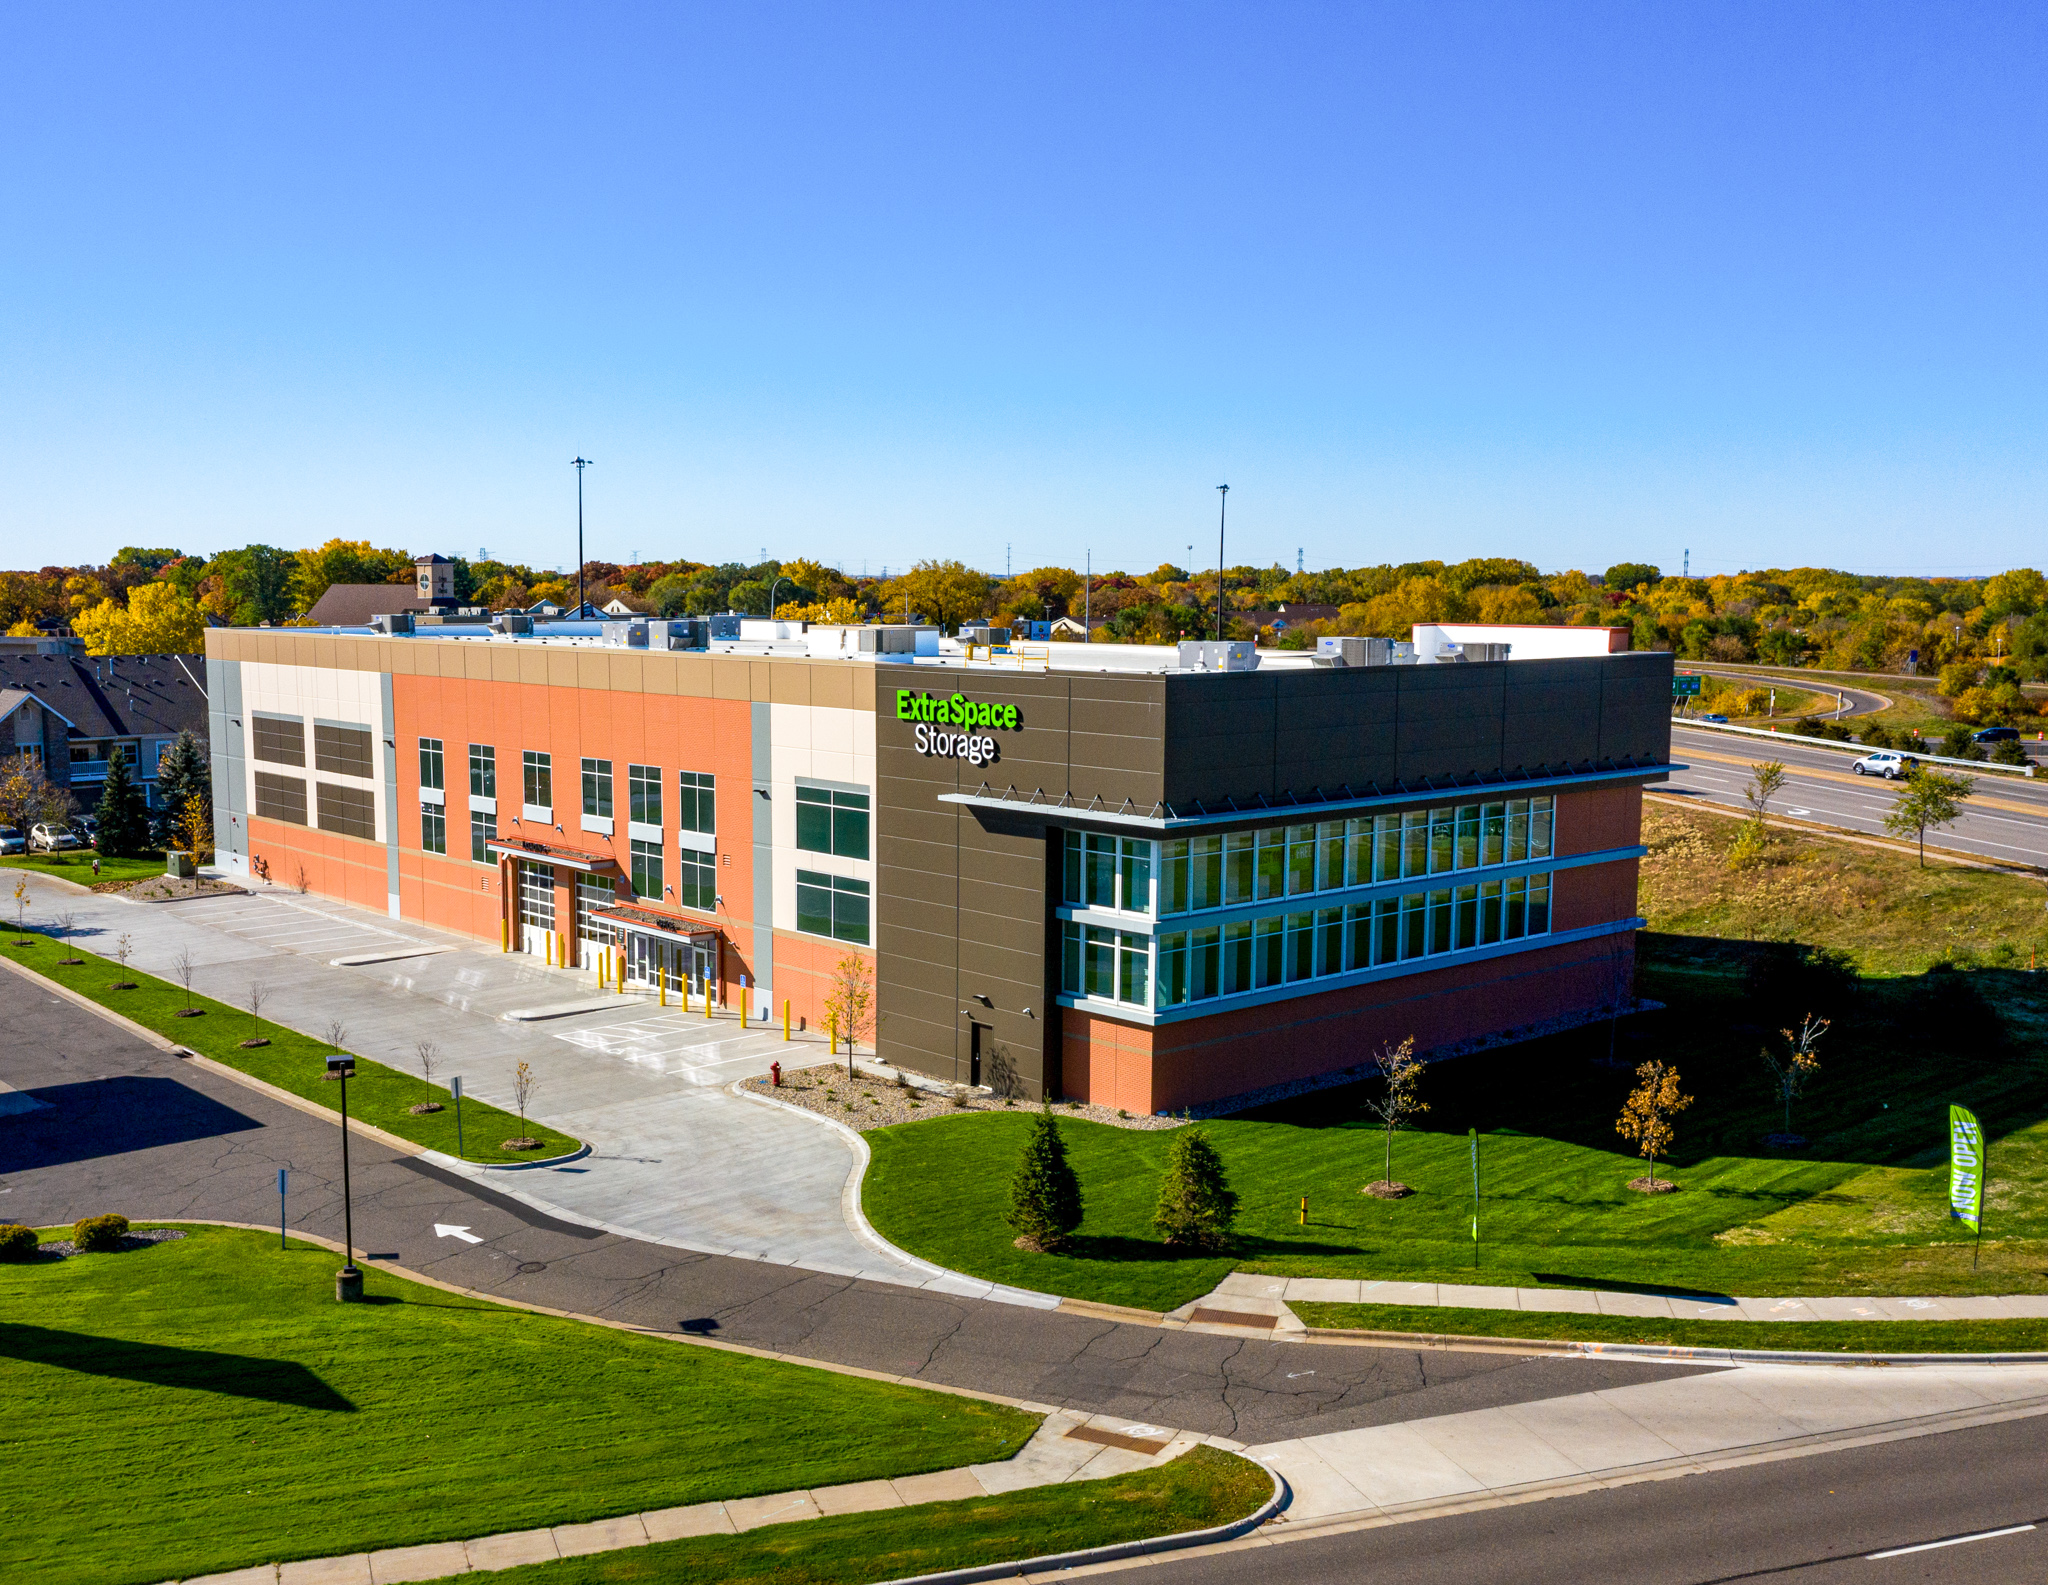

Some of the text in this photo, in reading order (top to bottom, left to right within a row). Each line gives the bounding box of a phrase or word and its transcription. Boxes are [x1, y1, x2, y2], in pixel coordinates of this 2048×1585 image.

[896, 690, 1017, 731] ExtraSpace
[914, 723, 994, 764] Storage
[1953, 1120, 1978, 1168] OPEN
[1951, 1169, 1976, 1211] NOW
